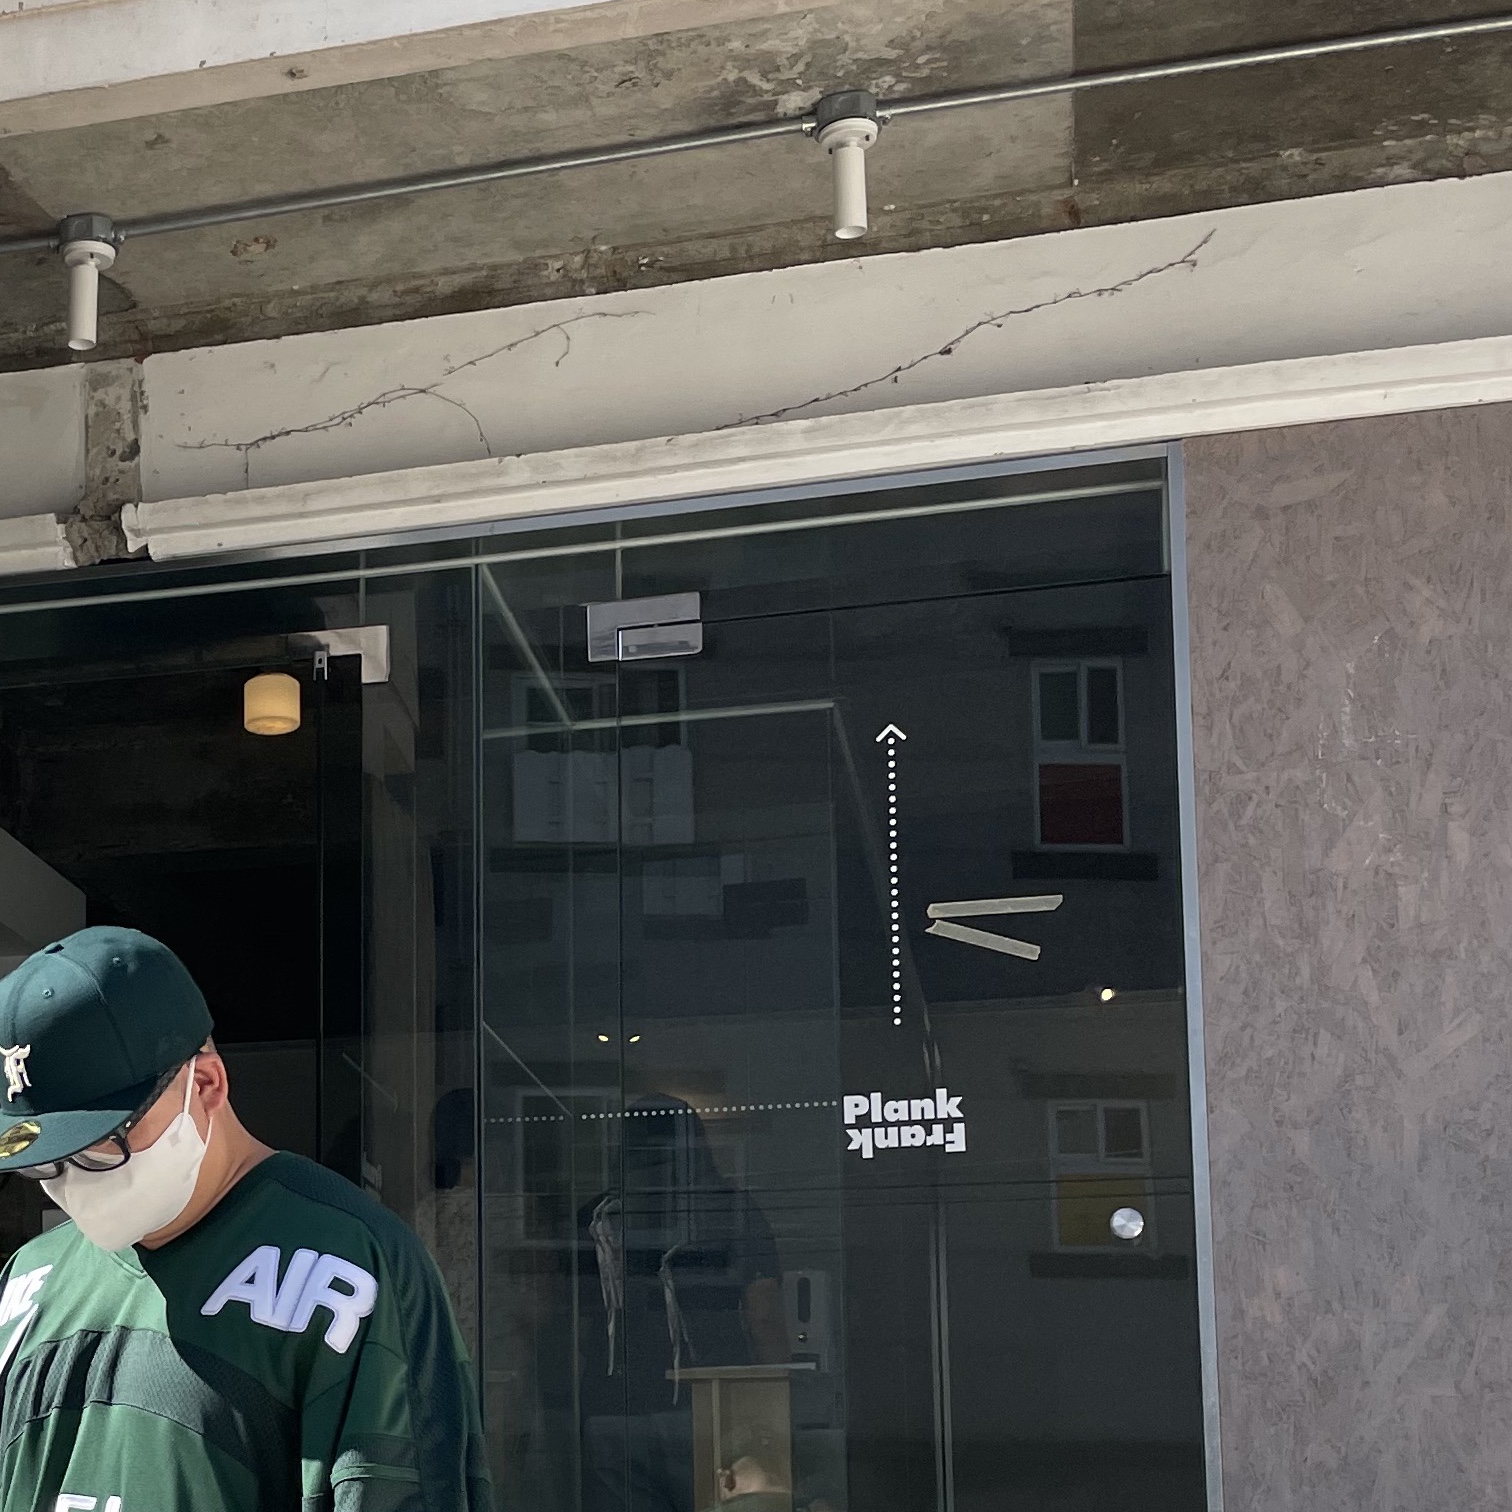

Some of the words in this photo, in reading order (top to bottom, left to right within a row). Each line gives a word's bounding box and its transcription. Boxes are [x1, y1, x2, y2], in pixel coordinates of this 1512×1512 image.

[843, 1088, 965, 1125] Plank
[845, 1122, 967, 1159] Frank
[200, 1245, 379, 1354] AIR
